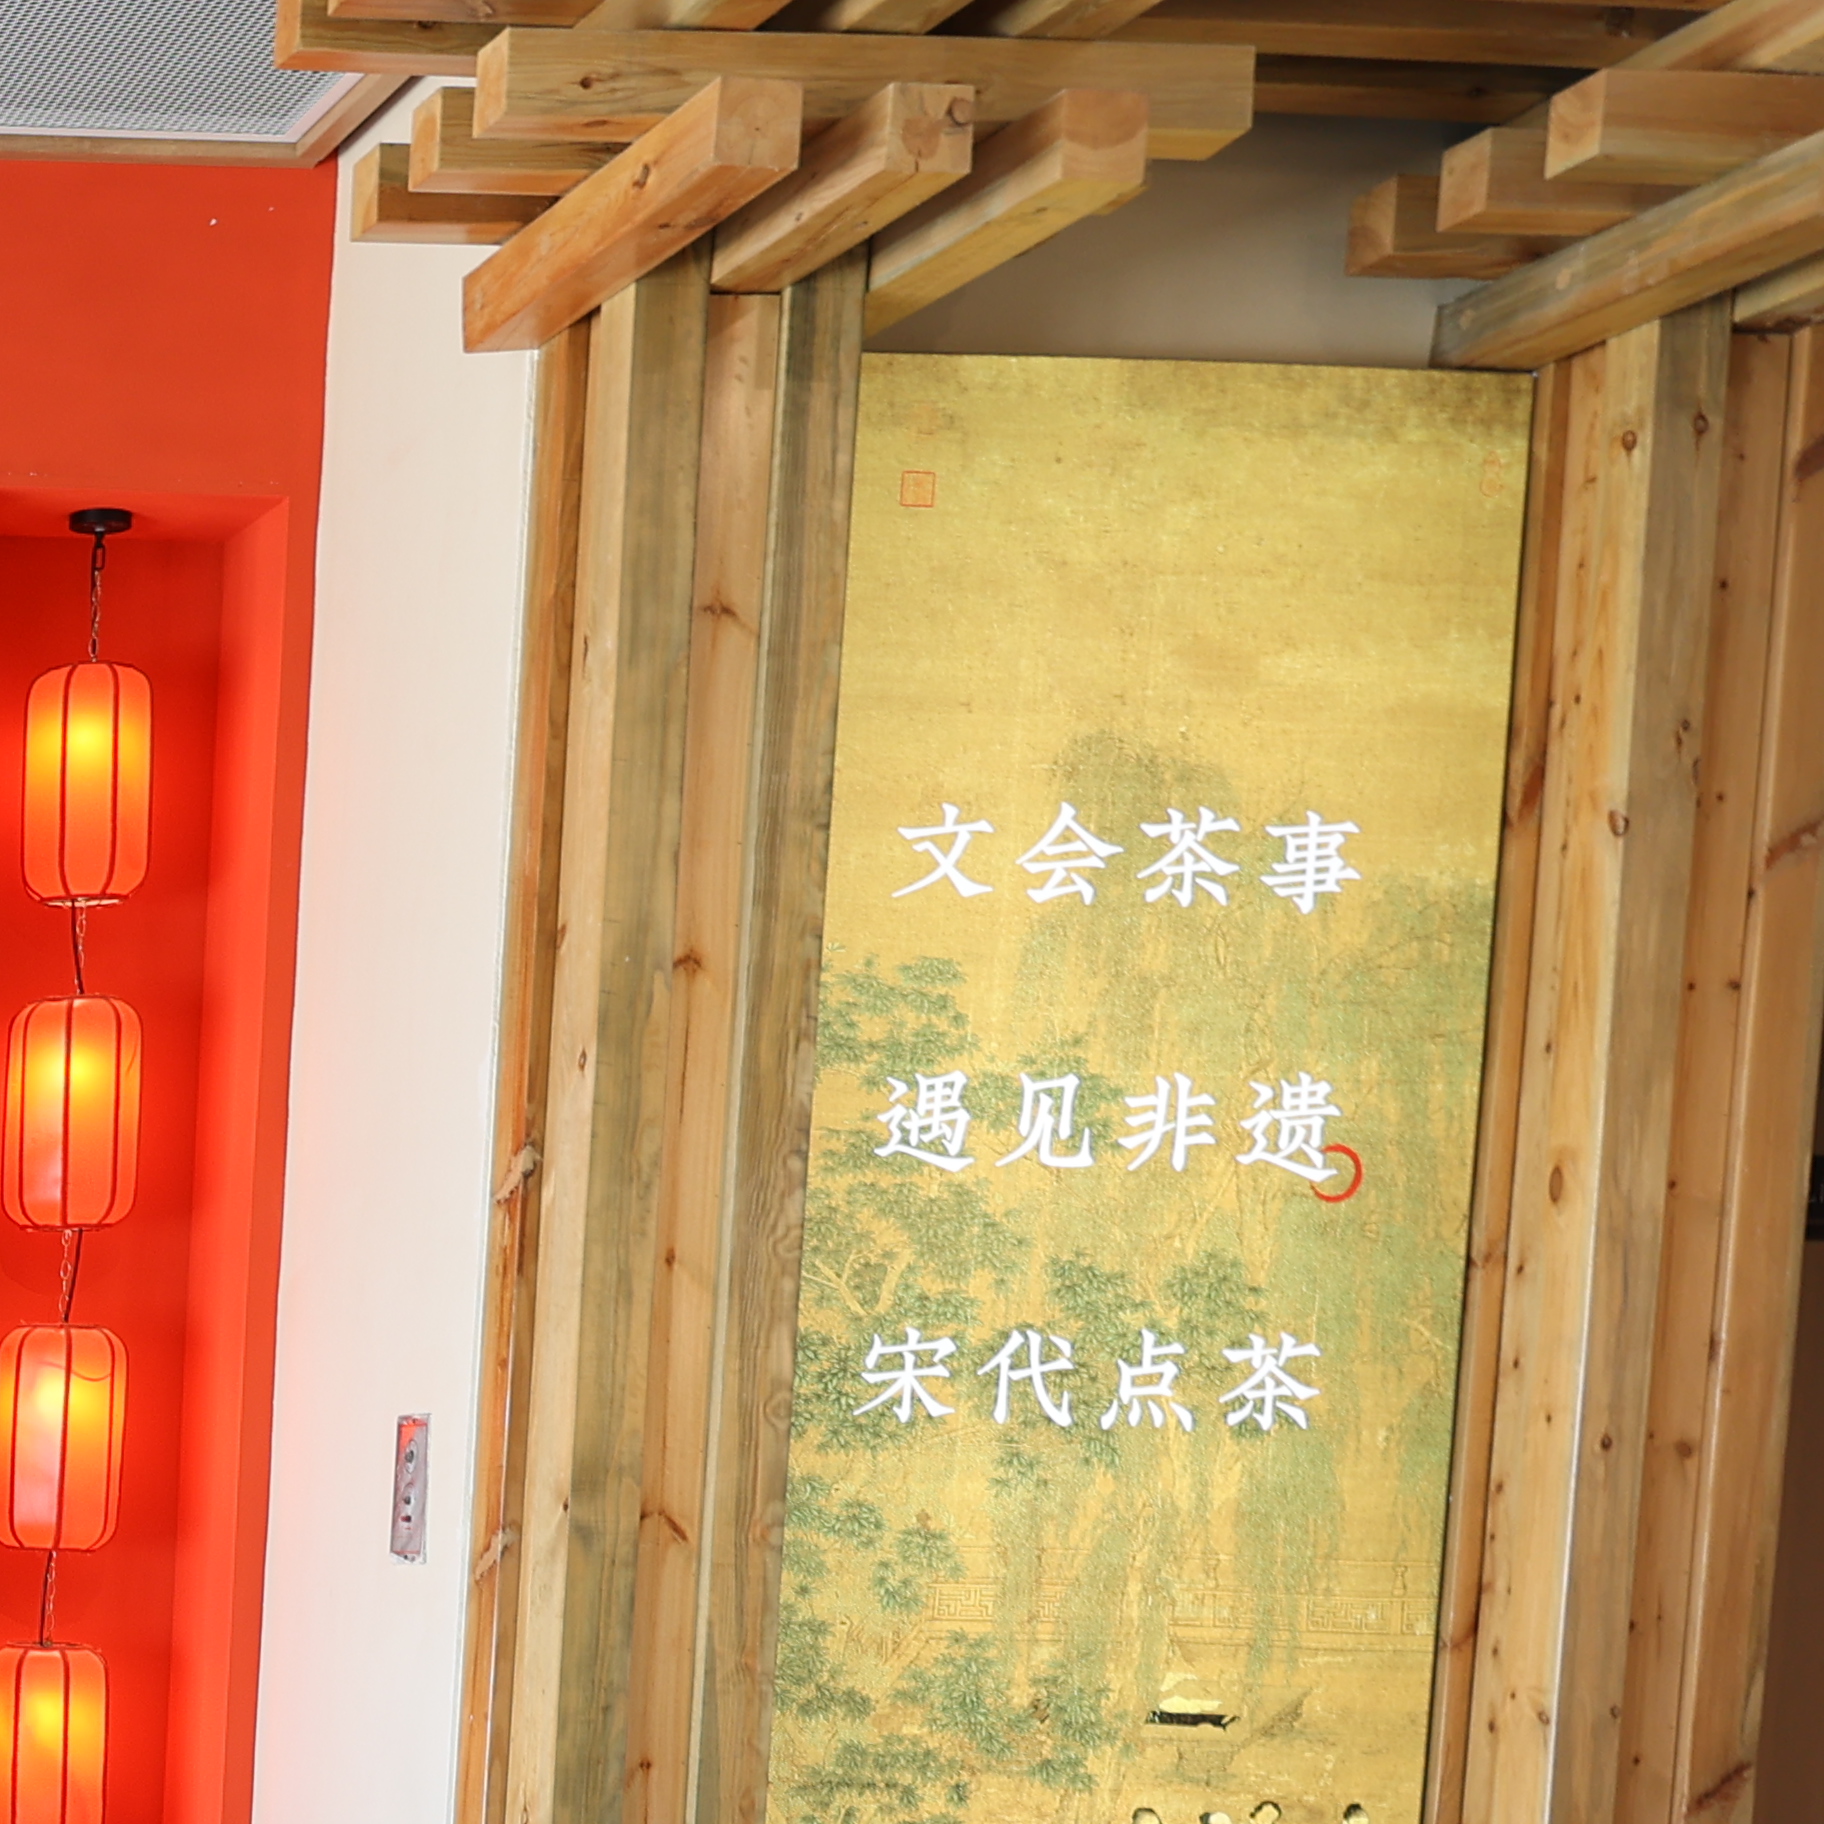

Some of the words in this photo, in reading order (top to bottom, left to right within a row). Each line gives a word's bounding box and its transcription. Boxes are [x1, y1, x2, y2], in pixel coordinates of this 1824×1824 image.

[890, 803, 1361, 914] 文会茶事
[874, 1070, 1341, 1182] 遇见非遗
[854, 1328, 1322, 1431] 宋代点茶
